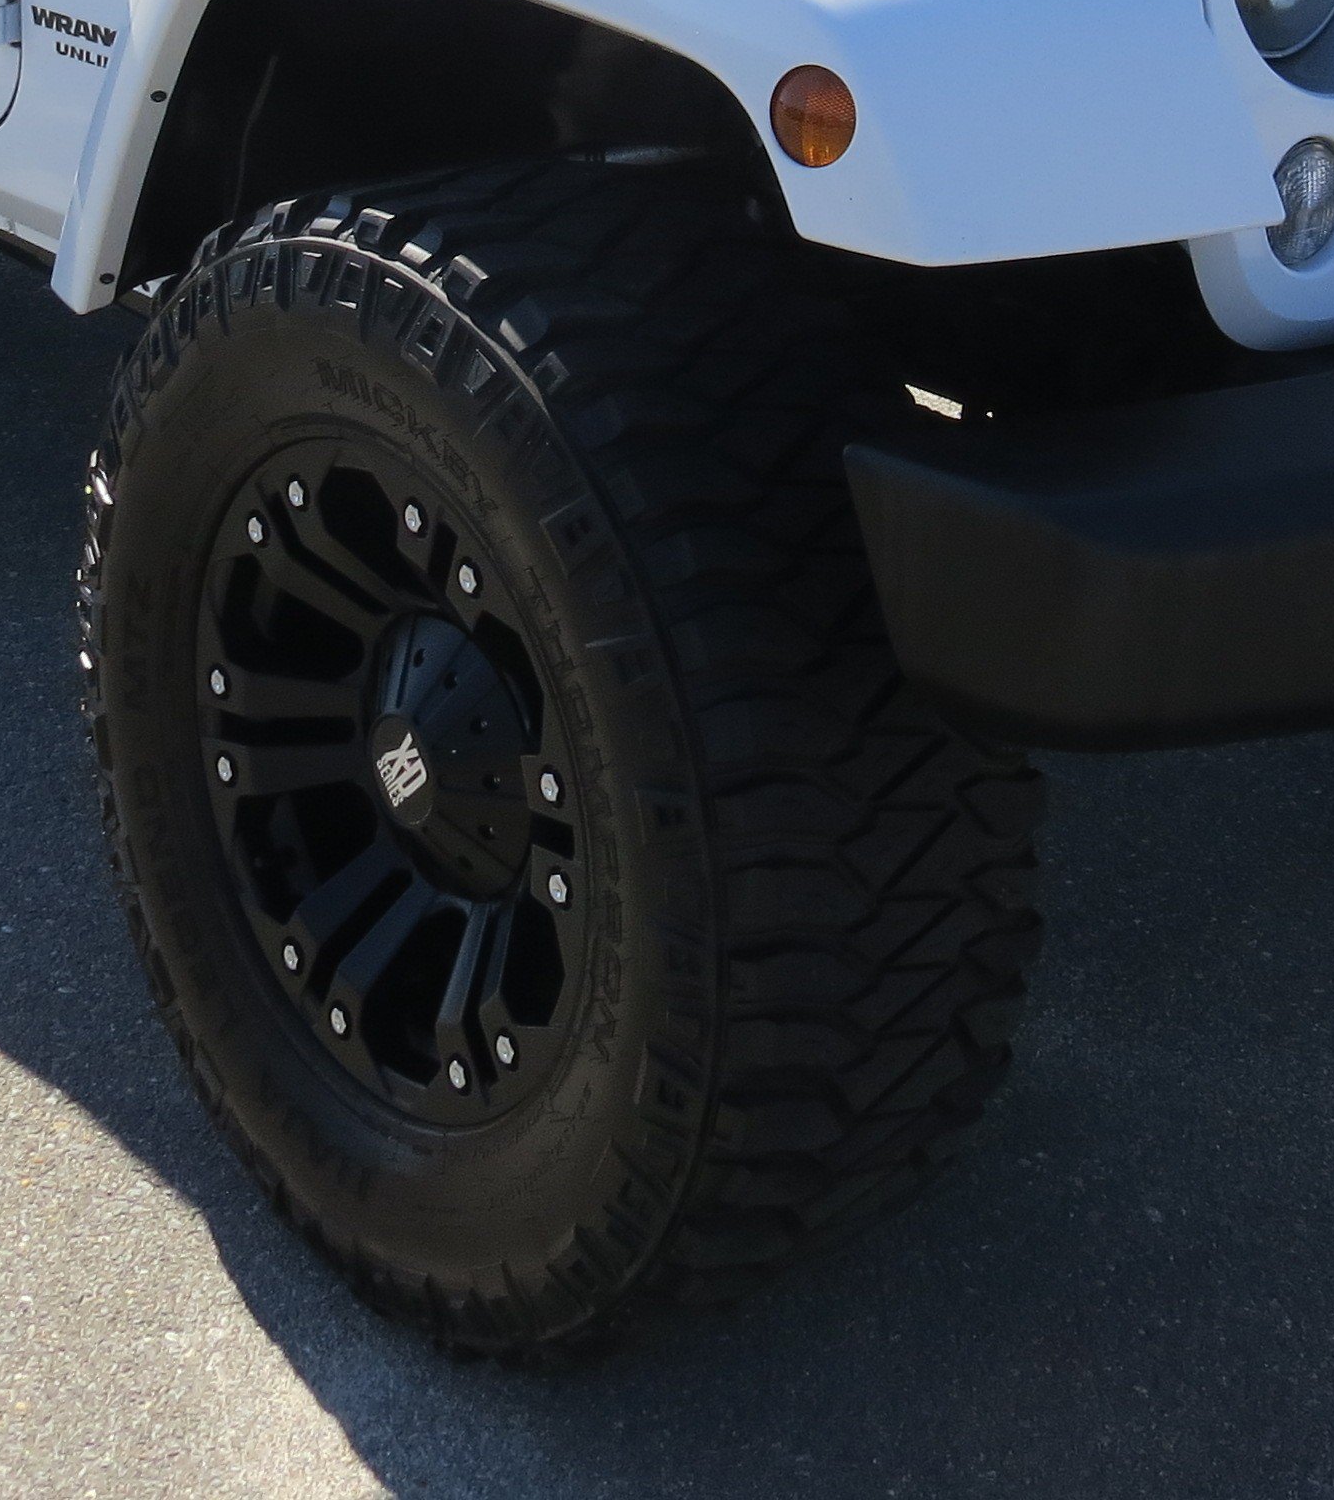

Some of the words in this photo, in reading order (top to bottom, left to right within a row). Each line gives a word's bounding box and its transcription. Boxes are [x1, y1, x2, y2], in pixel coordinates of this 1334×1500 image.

[31, 5, 117, 47] WRAN
[56, 41, 108, 69] UNLI
[312, 357, 498, 522] MICKEY
[376, 756, 404, 807] SERIES
